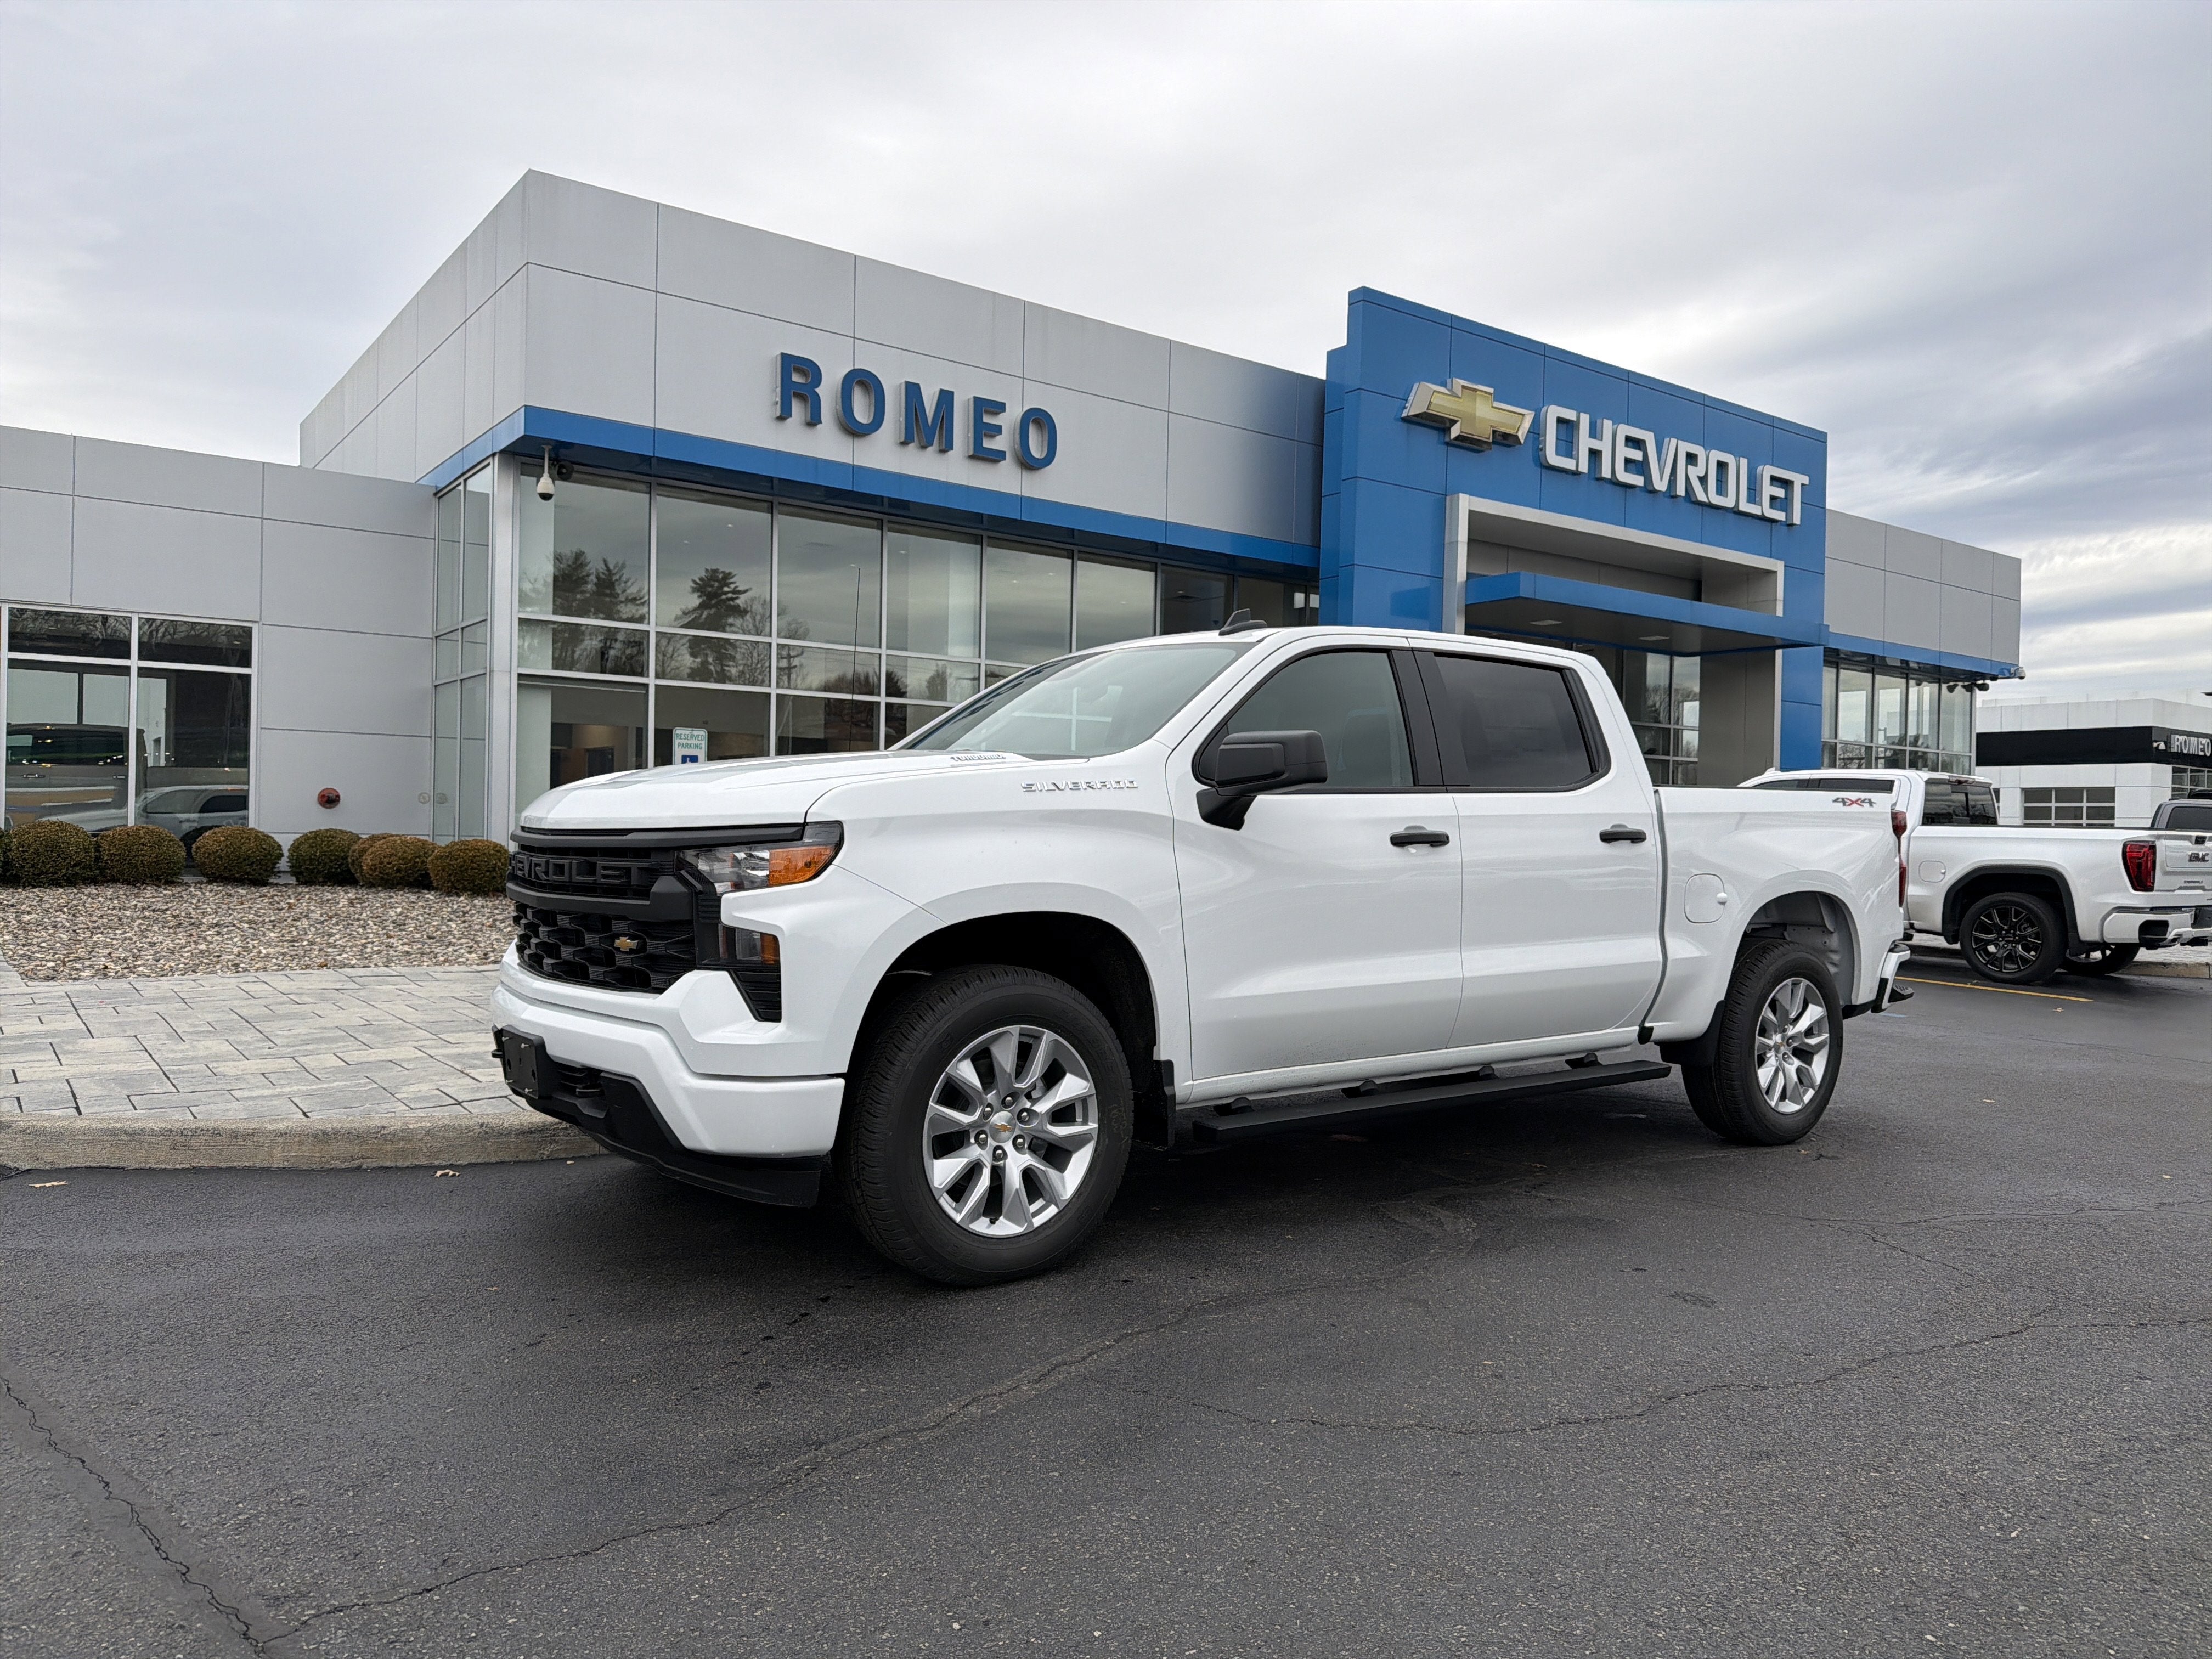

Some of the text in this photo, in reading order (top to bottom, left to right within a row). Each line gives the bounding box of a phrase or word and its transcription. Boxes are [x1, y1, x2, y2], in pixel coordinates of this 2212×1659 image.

[776, 352, 1057, 469] ROMEO
[1539, 405, 1809, 526] CHEVROLET
[675, 733, 705, 741] RESERVED
[2171, 735, 2211, 757] ROMEO
[1021, 779, 1138, 792] SILVERADO
[2188, 853, 2210, 863] GMC
[509, 854, 656, 885] HEVROLET
